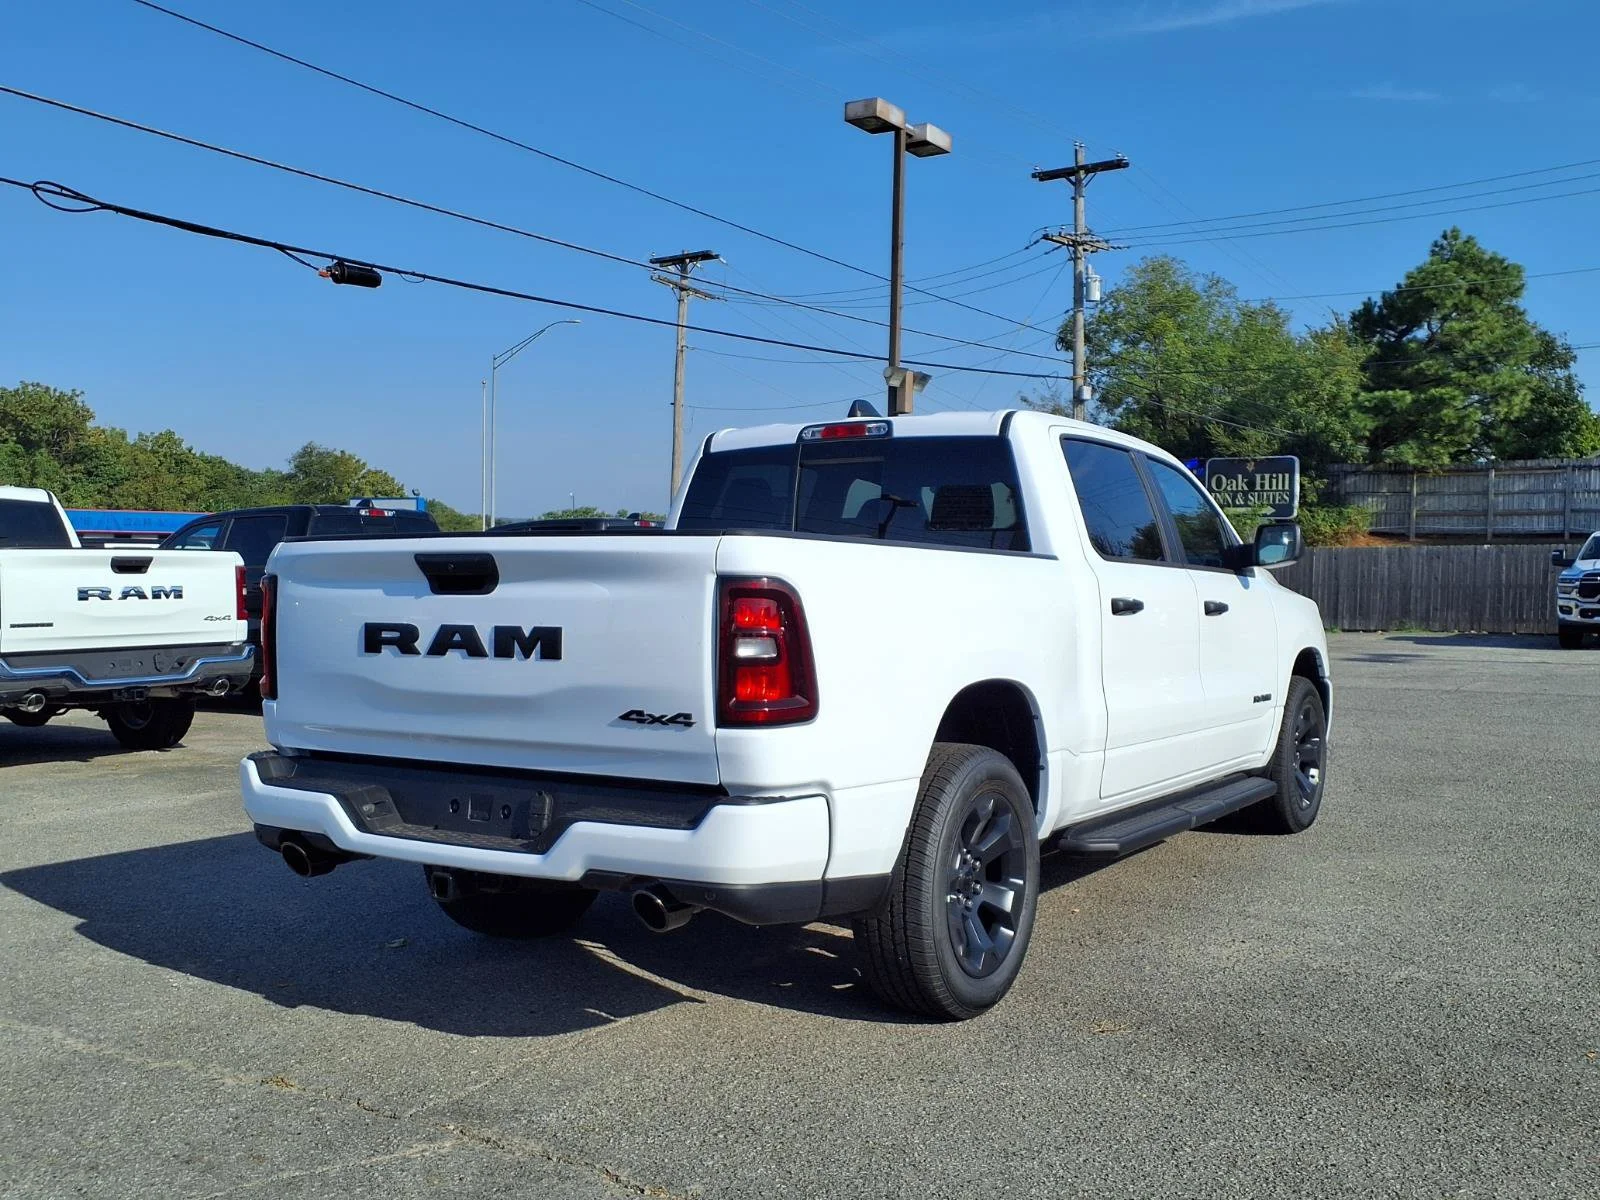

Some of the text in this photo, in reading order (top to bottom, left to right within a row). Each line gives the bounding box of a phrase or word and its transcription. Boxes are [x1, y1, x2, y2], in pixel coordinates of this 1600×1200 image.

[1211, 473, 1290, 491] Oak Hill
[1235, 492, 1246, 505] &
[1248, 491, 1290, 505] SUITES
[77, 585, 183, 601] RAM
[203, 614, 232, 622] 4x4
[364, 622, 563, 660] RAM
[618, 709, 697, 728] 4x4
